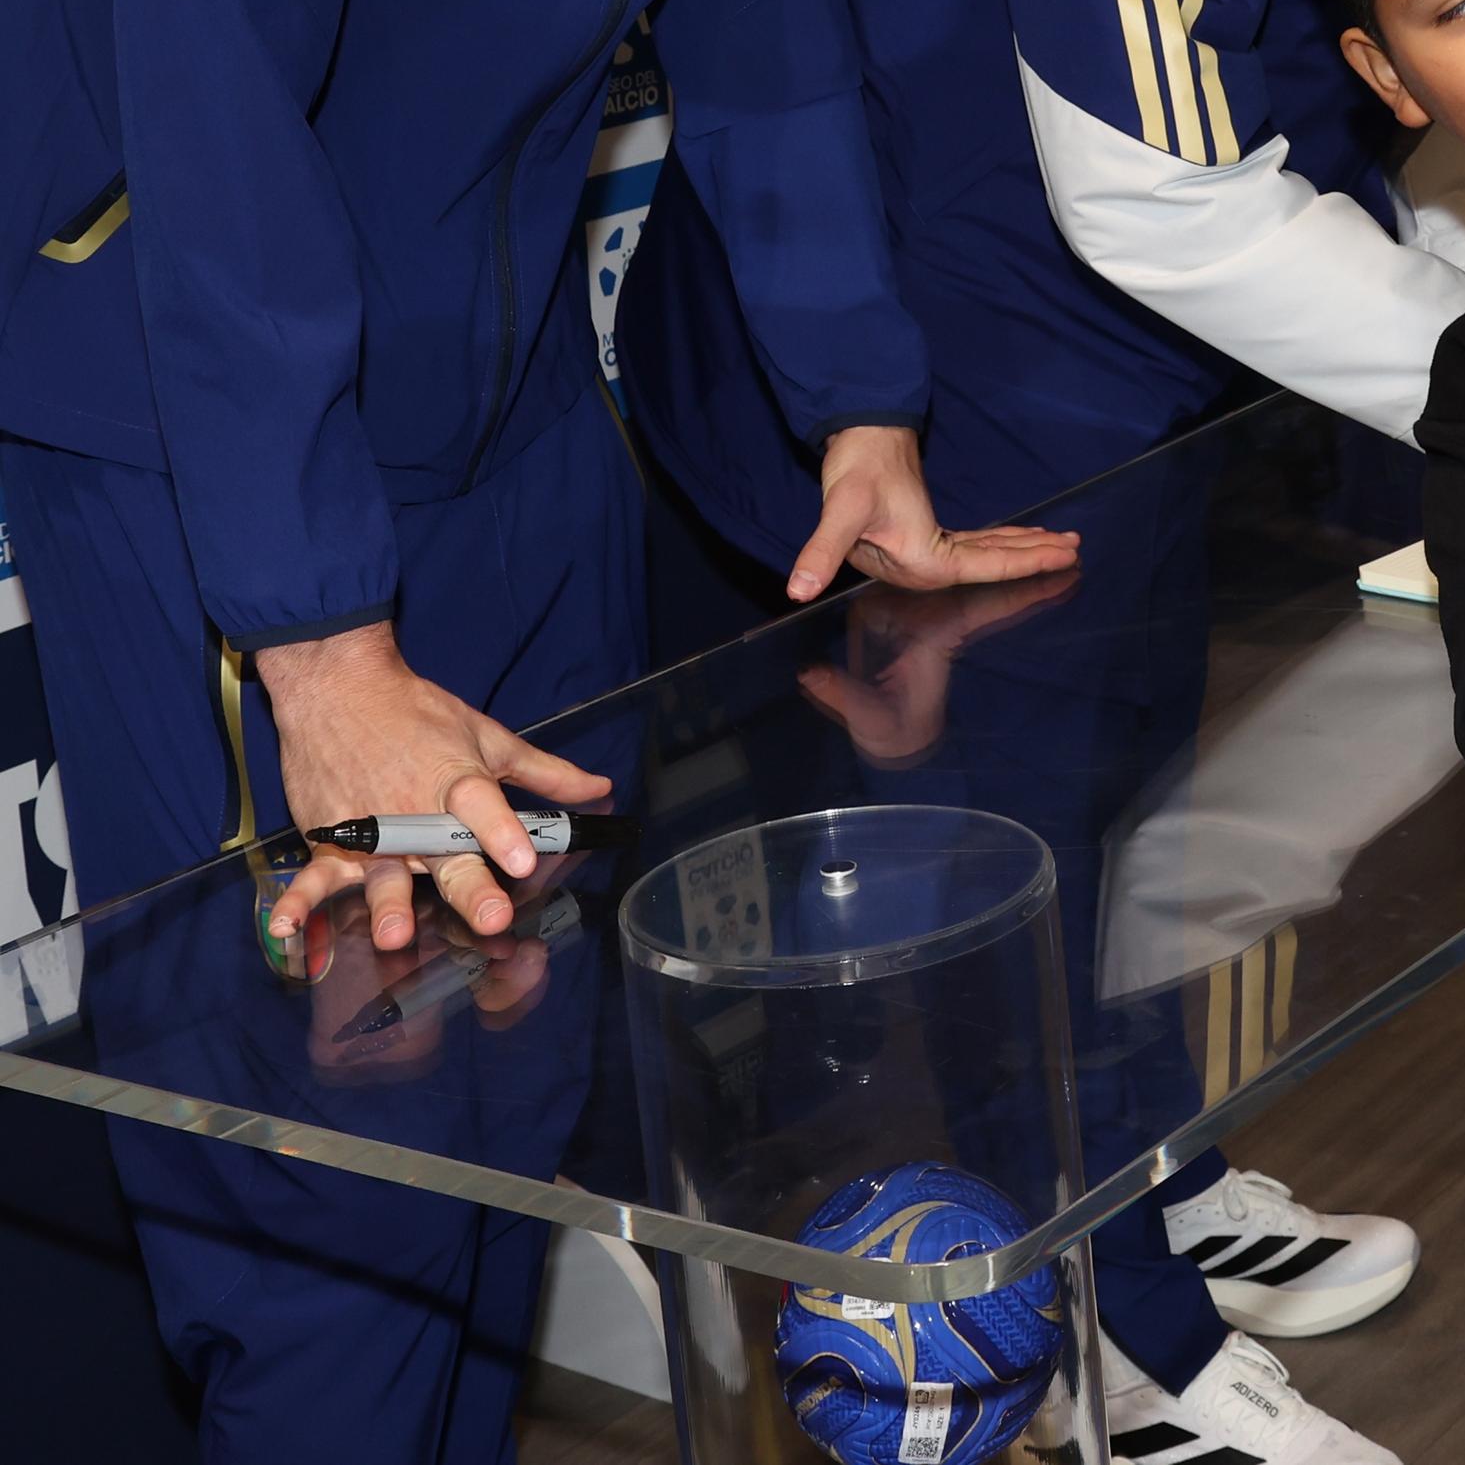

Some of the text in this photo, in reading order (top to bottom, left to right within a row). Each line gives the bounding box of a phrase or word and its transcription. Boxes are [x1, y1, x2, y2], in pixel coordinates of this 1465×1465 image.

[608, 75, 632, 93] SEO
[604, 86, 659, 116] ALCIO
[1230, 1381, 1279, 1418] ADIZERO
